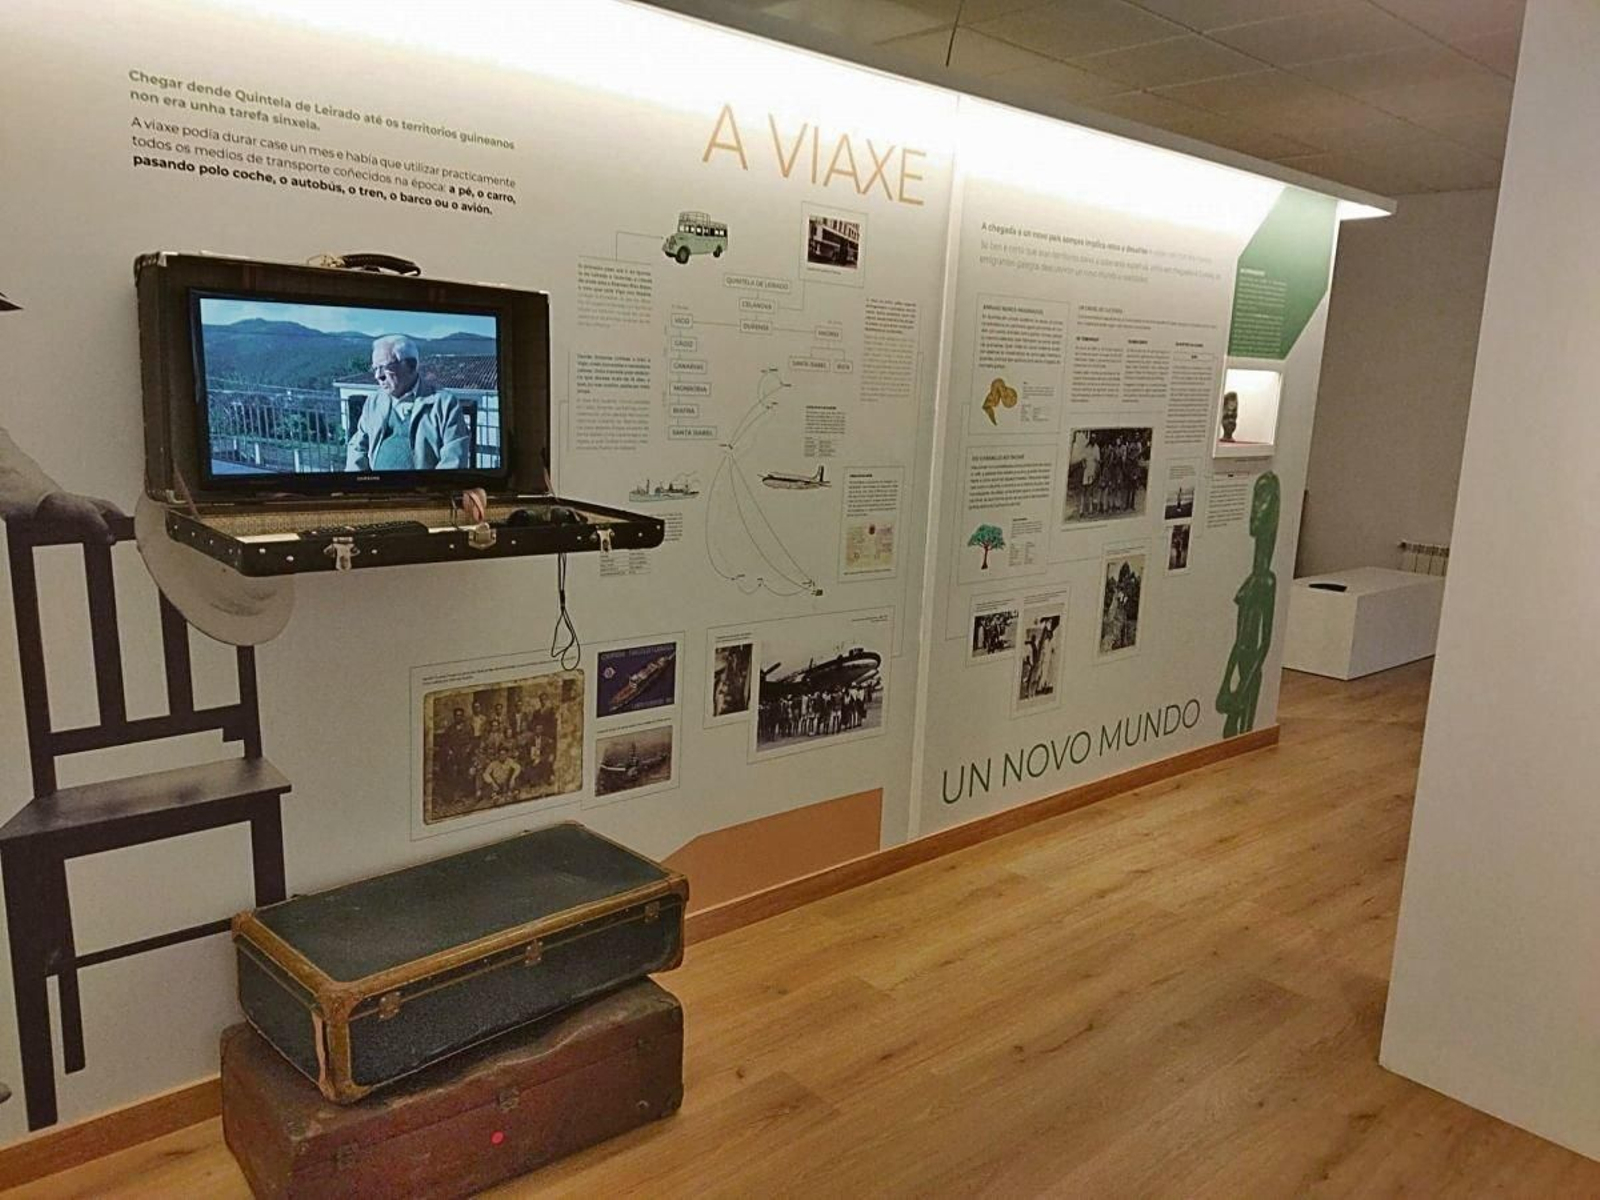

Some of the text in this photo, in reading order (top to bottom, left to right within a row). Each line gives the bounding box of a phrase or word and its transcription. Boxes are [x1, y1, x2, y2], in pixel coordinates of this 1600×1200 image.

[128, 70, 515, 150] Chegar dende Quintela de Leirado até os territorios guineanos
[130, 90, 321, 131] non era unha tarefa sinxela.
[131, 116, 142, 129] A
[144, 119, 180, 134] viaxe
[182, 125, 220, 141] podía
[222, 131, 257, 146] durar
[259, 140, 288, 152] case
[290, 144, 306, 155] un
[308, 147, 334, 159] mes
[336, 151, 344, 160] e
[345, 150, 378, 166] había
[379, 157, 402, 170] que
[403, 160, 439, 176] utilizar
[132, 136, 172, 152] todos
[175, 143, 191, 154] os
[194, 145, 244, 162] medios
[246, 154, 263, 165] de
[266, 155, 331, 175] transporte
[332, 166, 392, 184] coñecidos
[394, 176, 409, 186] na
[448, 185, 456, 194] a
[458, 185, 475, 198] pé,
[477, 190, 485, 198] o
[486, 191, 517, 204] carro,
[701, 103, 927, 206] A VIAXE
[133, 154, 493, 215] pasando polo coche, o autobús, o tren, o barco ou o avión.
[941, 698, 1201, 805] UN NOVO MUNDO
